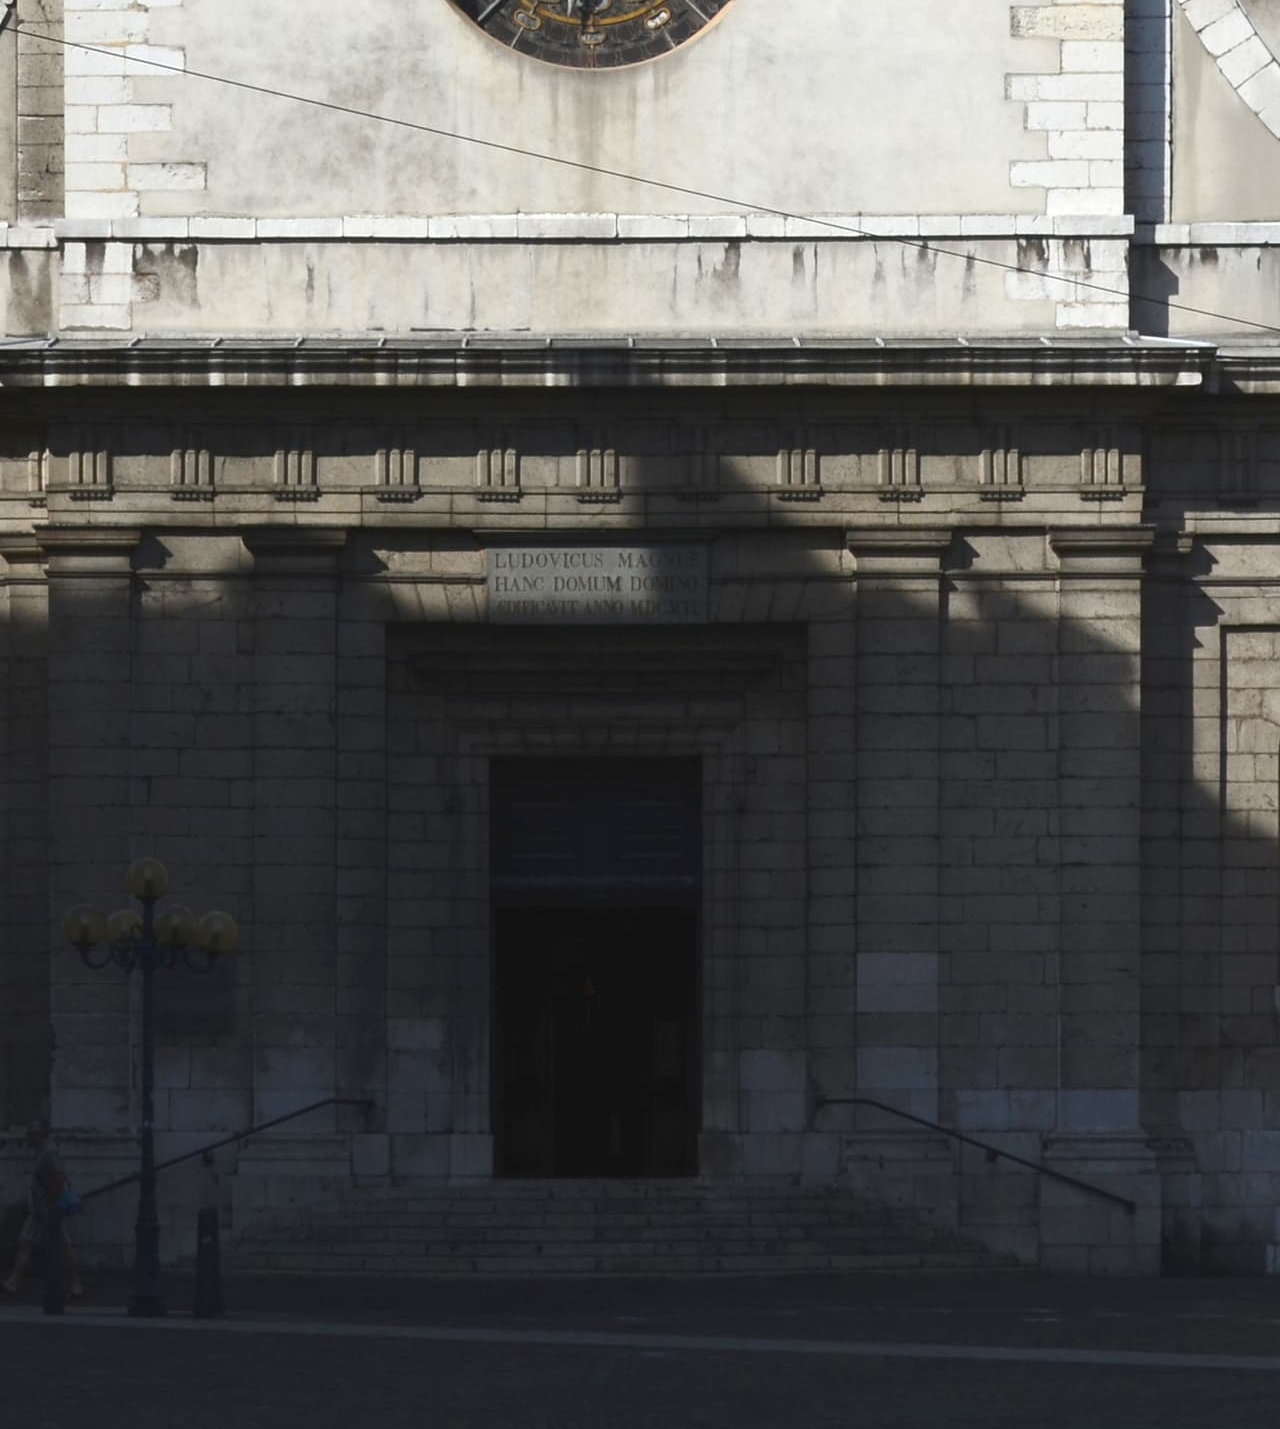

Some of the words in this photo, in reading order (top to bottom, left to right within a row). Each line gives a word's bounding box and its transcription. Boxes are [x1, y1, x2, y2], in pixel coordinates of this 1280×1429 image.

[494, 551, 604, 569] LUDOVICUS
[618, 551, 699, 569] MAGNUS
[494, 575, 545, 593] HANC
[553, 575, 622, 593] DOMUM
[585, 600, 624, 617] ANNO
